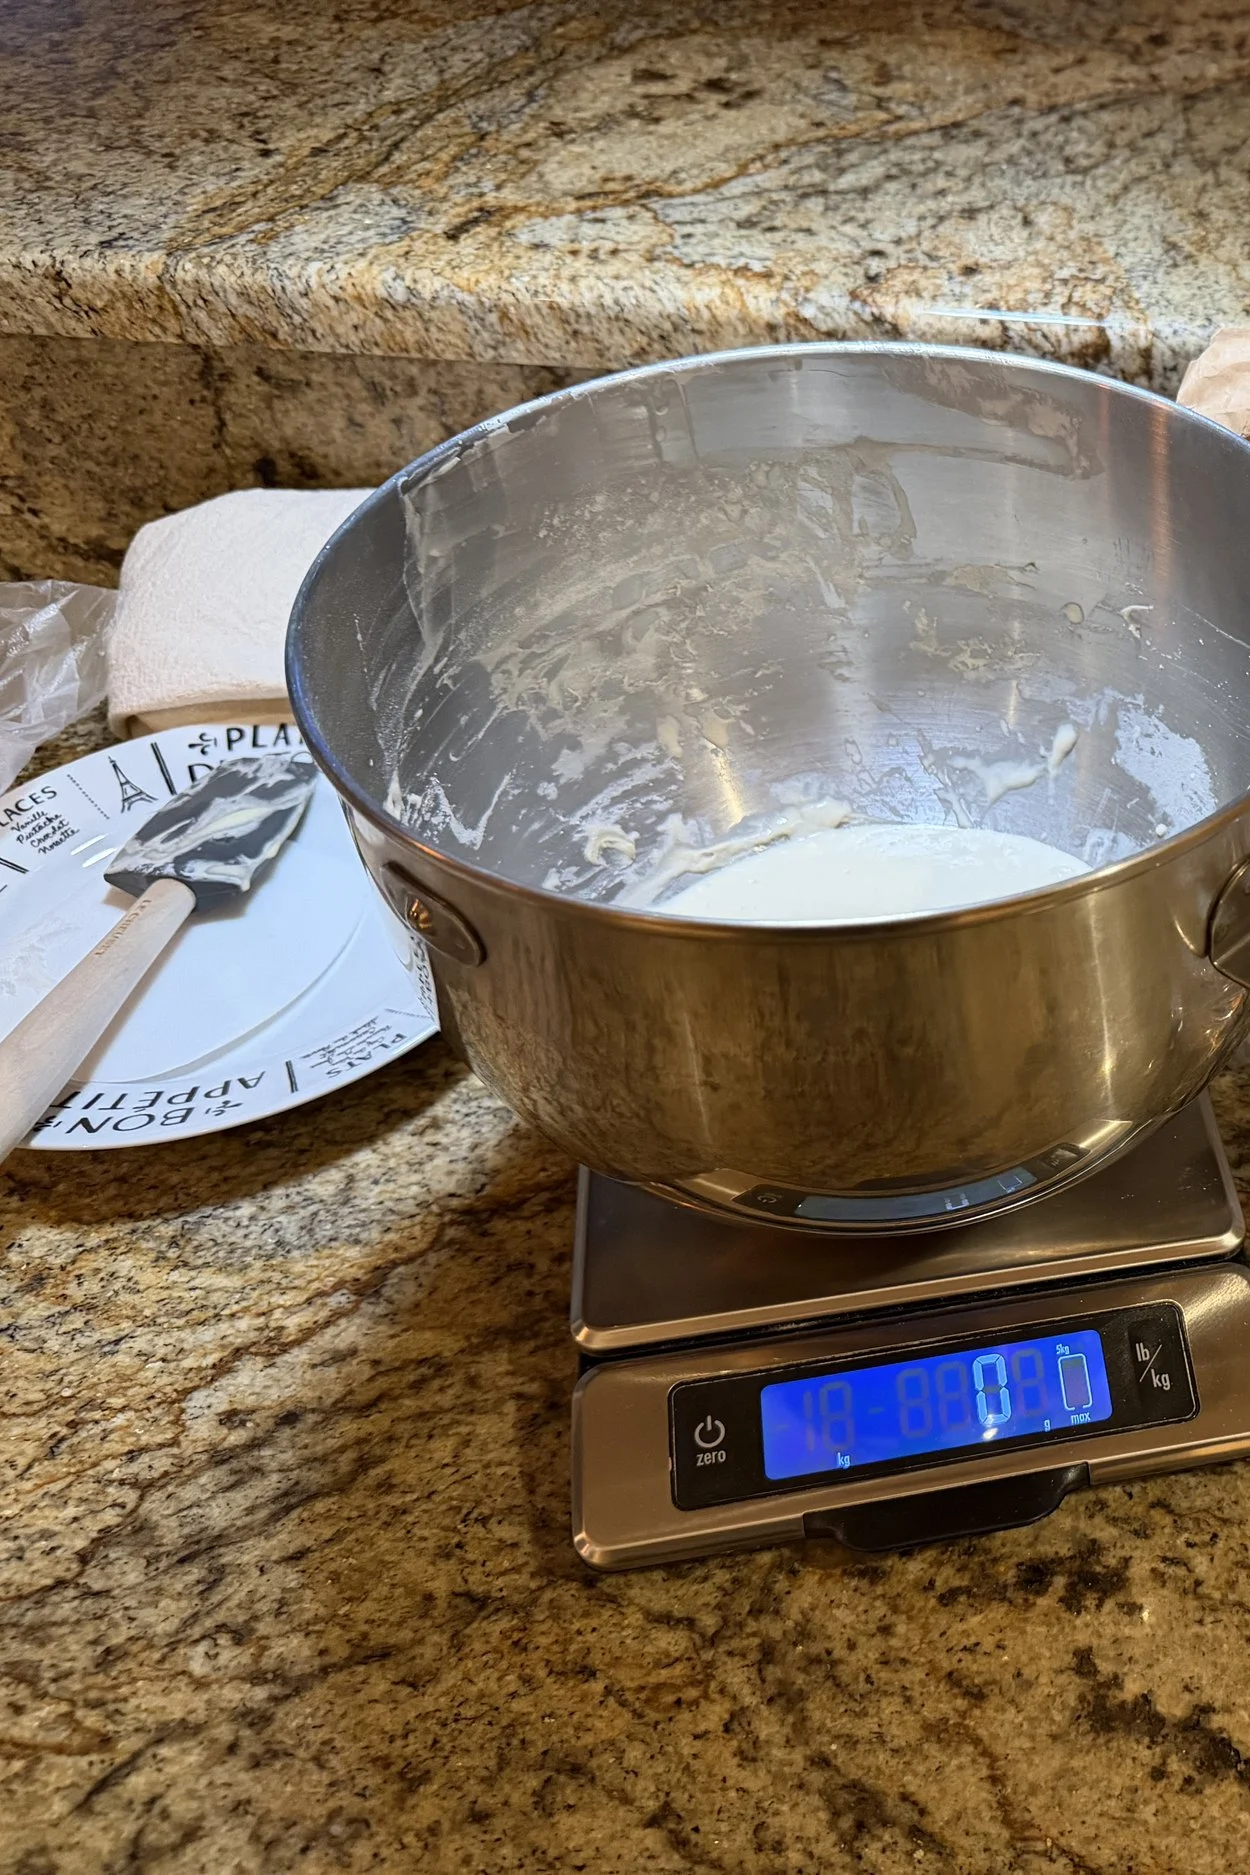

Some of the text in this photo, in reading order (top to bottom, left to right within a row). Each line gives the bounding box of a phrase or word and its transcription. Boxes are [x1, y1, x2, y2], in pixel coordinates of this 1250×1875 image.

[226, 723, 304, 751] PLA
[65, 1107, 195, 1134] BON
[1056, 1344, 1070, 1355] 5kg
[973, 1353, 1011, 1426] 0
[1044, 1419, 1051, 1432] g
[1071, 1411, 1091, 1425] max
[696, 1450, 726, 1467] zero
[838, 1452, 850, 1468] kg
